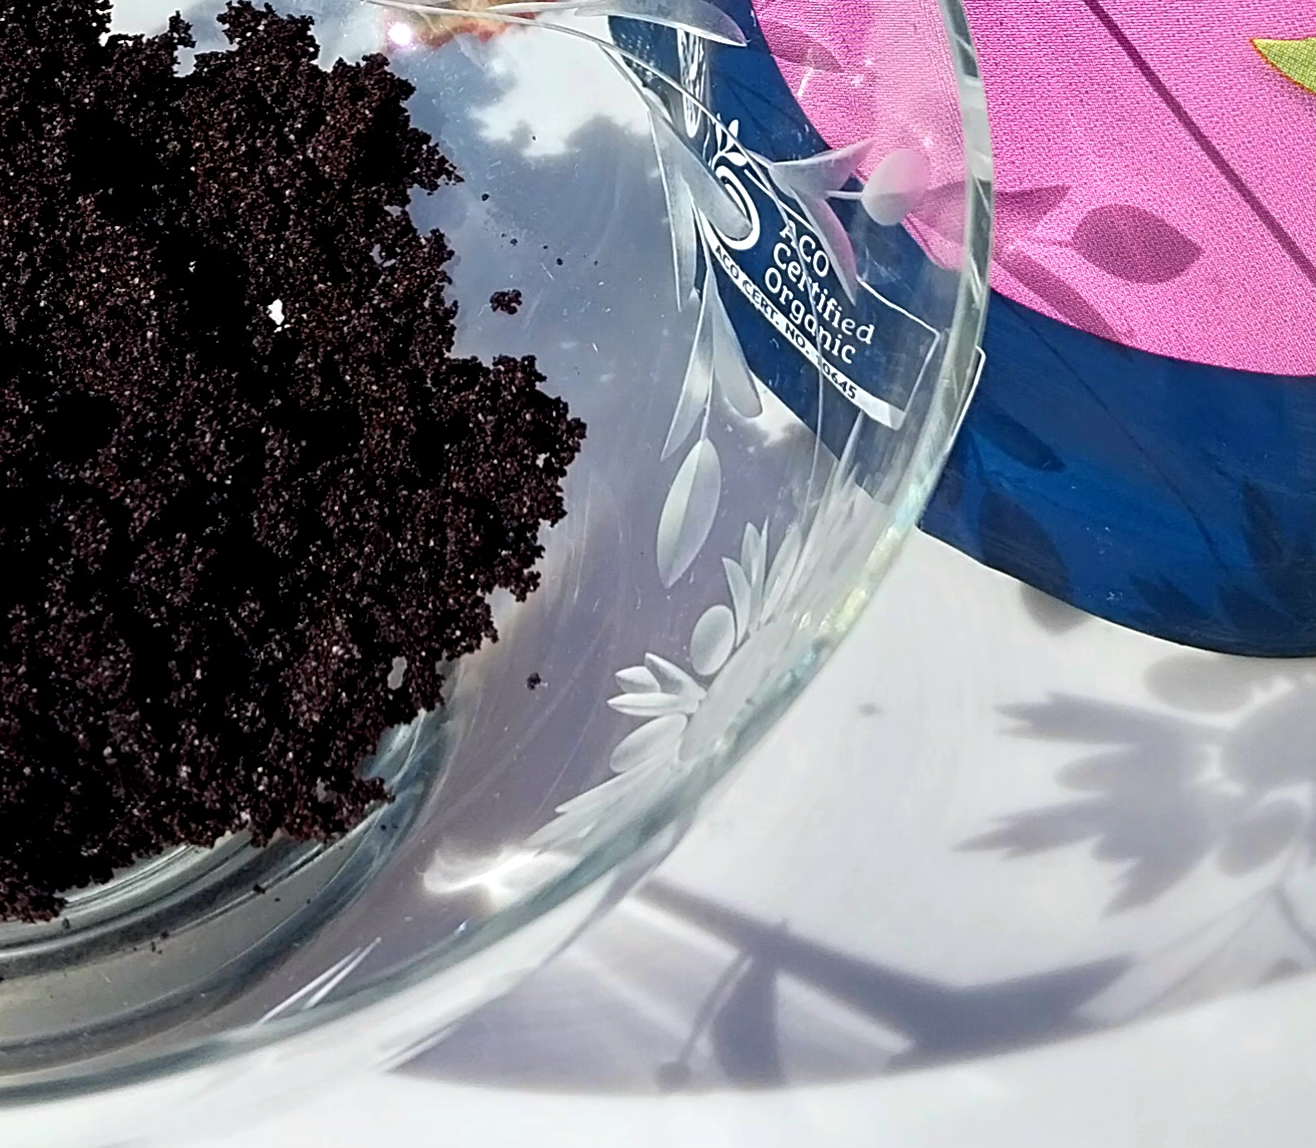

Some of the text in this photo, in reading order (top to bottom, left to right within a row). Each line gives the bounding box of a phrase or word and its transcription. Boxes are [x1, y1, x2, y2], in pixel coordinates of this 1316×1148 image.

[773, 243, 875, 344] Certified
[780, 220, 830, 277] ACO
[716, 245, 739, 280] ACO
[742, 279, 780, 326] CERT.
[784, 323, 810, 355] NO.
[765, 267, 856, 364] Organic
